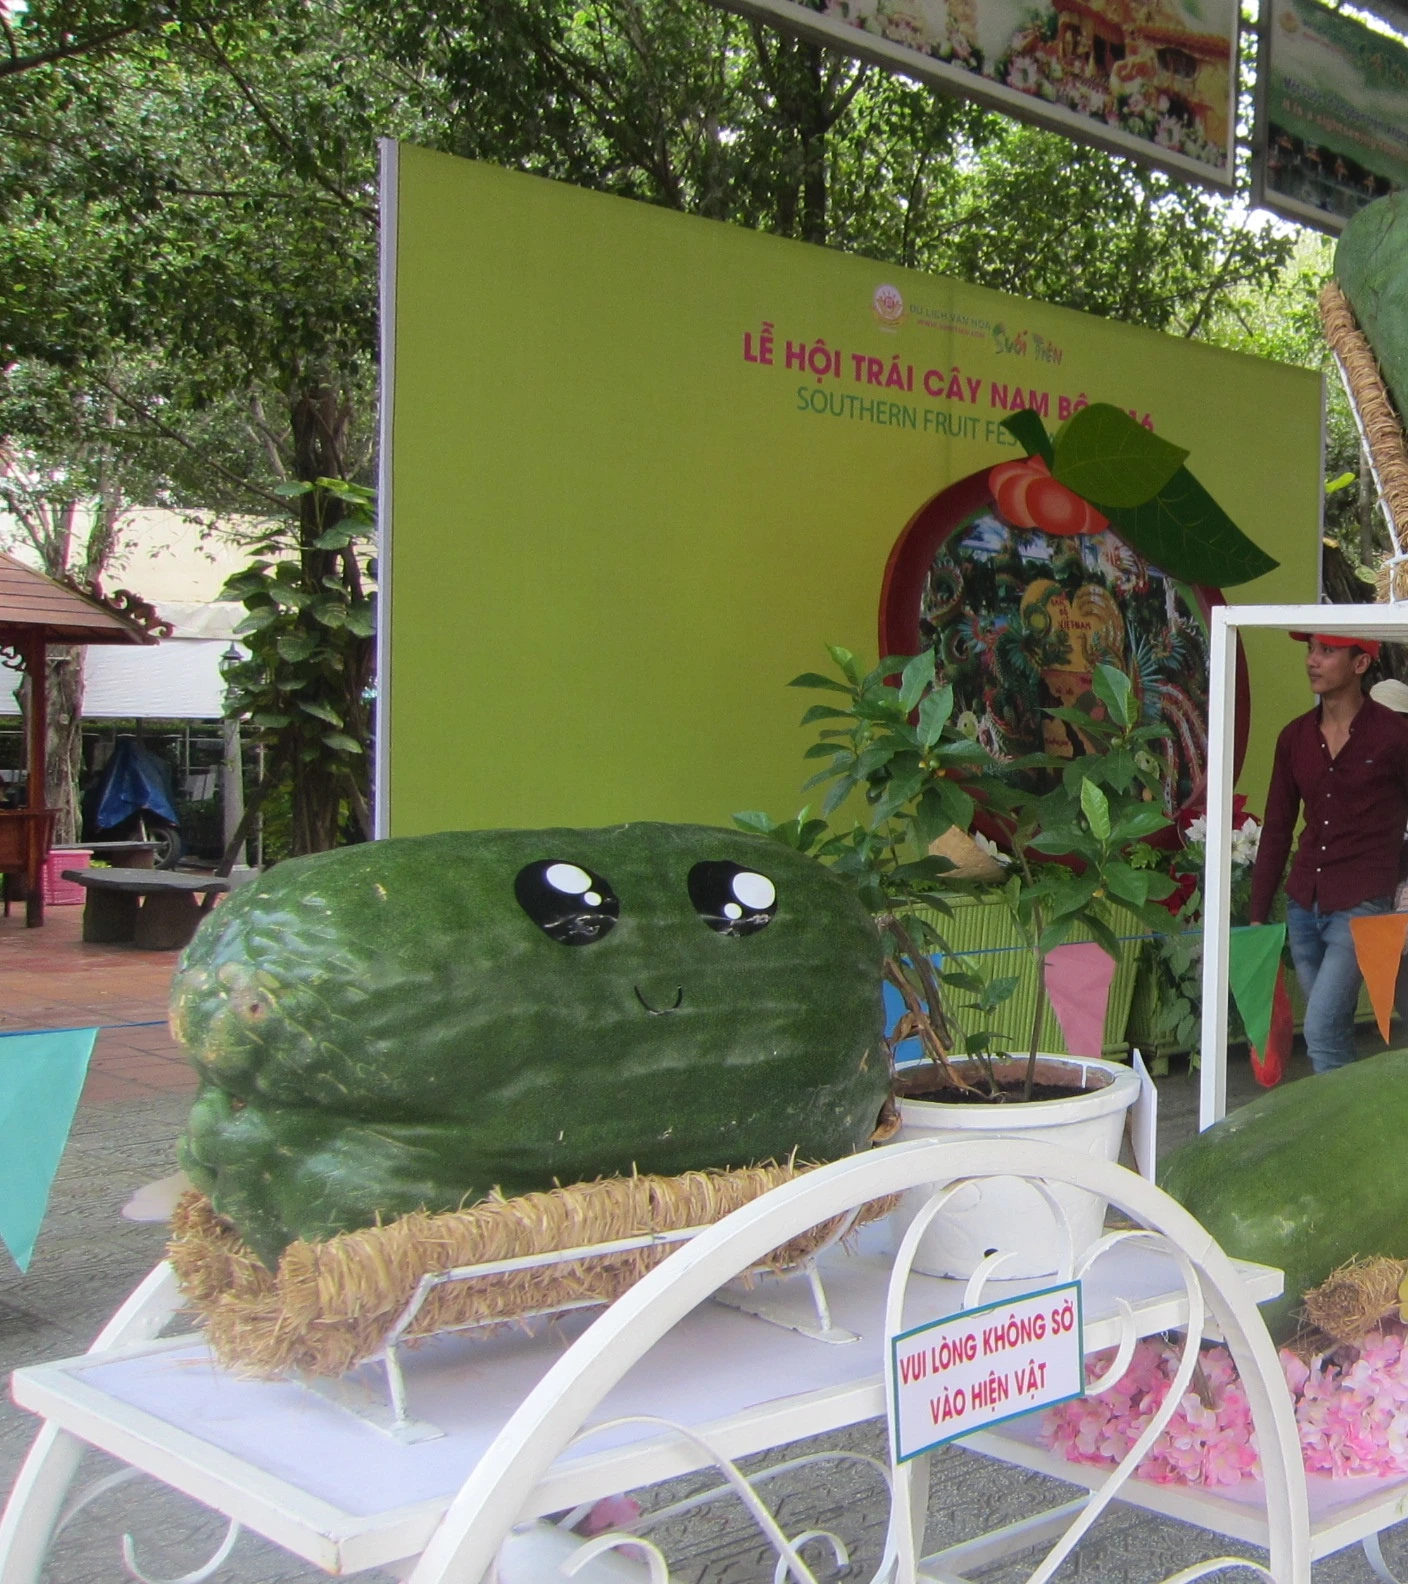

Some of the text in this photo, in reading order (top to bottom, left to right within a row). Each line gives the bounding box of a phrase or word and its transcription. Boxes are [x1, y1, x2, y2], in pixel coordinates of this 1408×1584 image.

[743, 321, 774, 366] LỄ
[785, 338, 841, 384] HỘI
[851, 355, 913, 391] TRÁI
[923, 366, 982, 404] CÂY
[991, 381, 1049, 419] NAM
[796, 386, 917, 430] SOUTHERN
[923, 410, 980, 442] FRUIT
[900, 1298, 1074, 1385] VUI LÒNG KHÔNG SỜ
[930, 1358, 1047, 1425] VÀO HIỆN VẬT
